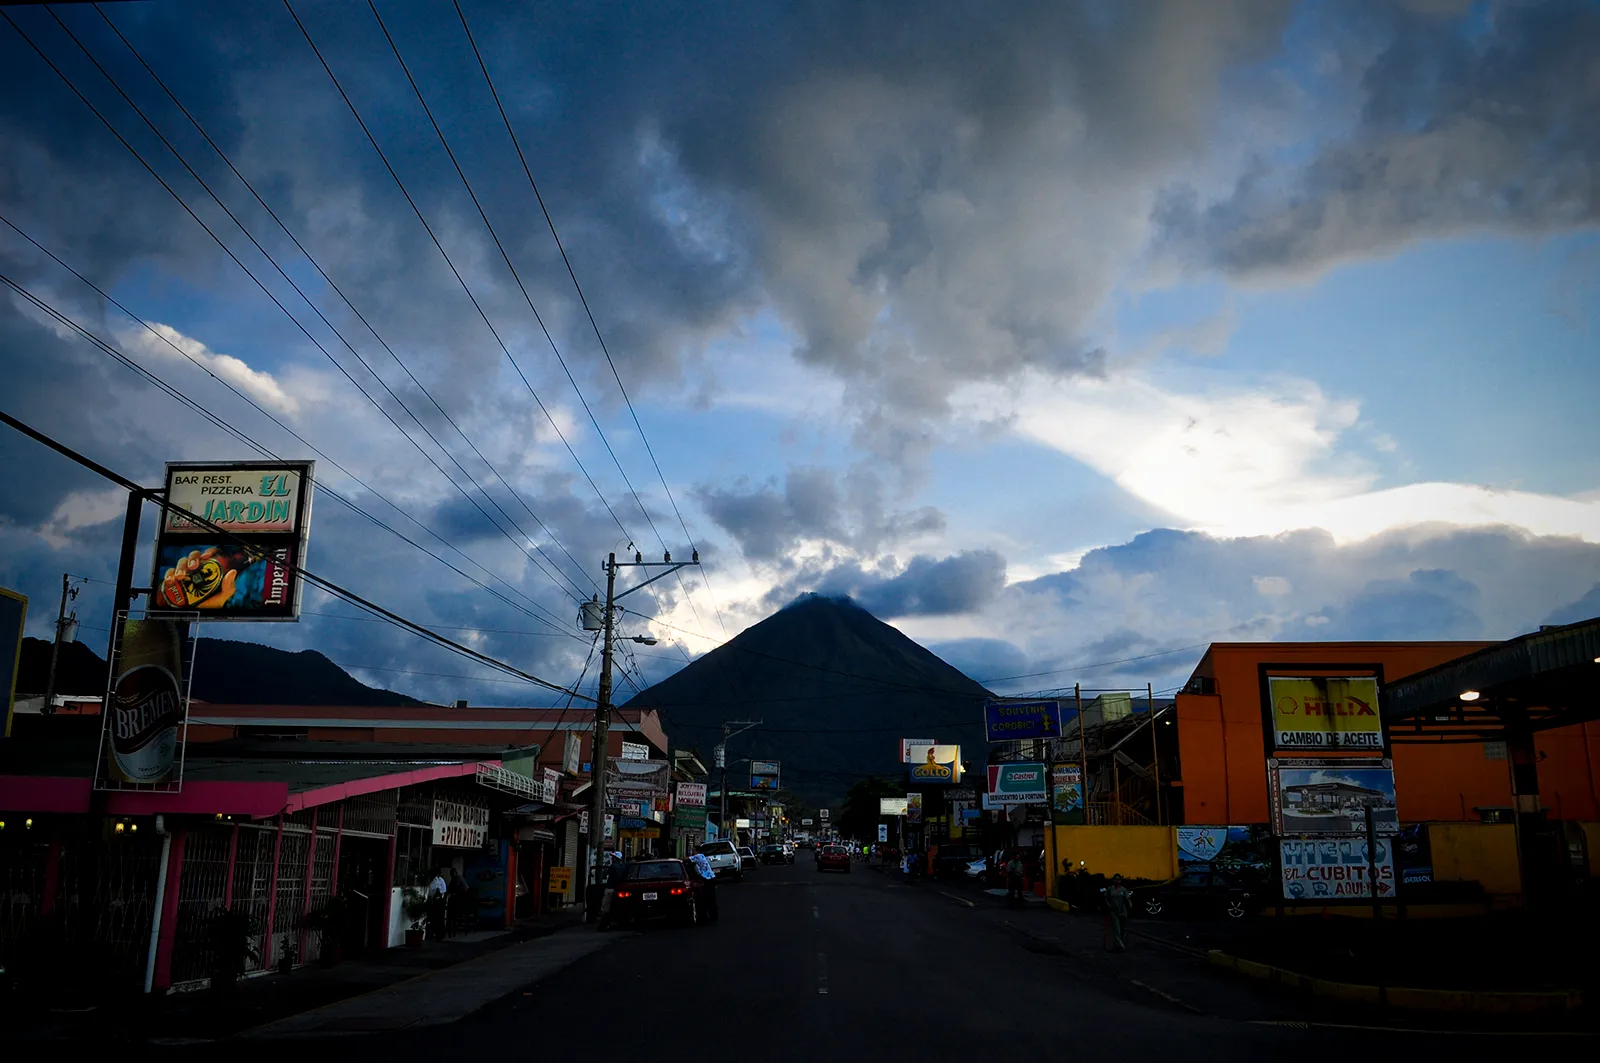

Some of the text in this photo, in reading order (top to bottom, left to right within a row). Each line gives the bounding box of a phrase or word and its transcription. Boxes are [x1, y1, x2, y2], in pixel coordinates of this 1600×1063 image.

[175, 475, 232, 485] BAR REST.
[259, 475, 292, 497] EL
[201, 486, 253, 495] PIZZERIA
[202, 500, 291, 524] JARDIN
[264, 548, 291, 606] Imperial
[998, 705, 1046, 717] SOUVENIR
[1304, 702, 1373, 716] HELIX
[992, 721, 1035, 732] COROBICI
[1281, 732, 1379, 745] CAMBIO DE ACEITE
[914, 769, 950, 777] GOLLO
[1013, 772, 1036, 780] Castrol
[618, 788, 651, 797] Comercial
[434, 801, 462, 823] COMIDAS
[446, 826, 477, 847] PITO PITO
[1283, 842, 1386, 865] HIELO
[1306, 866, 1392, 881] CUBITOS
